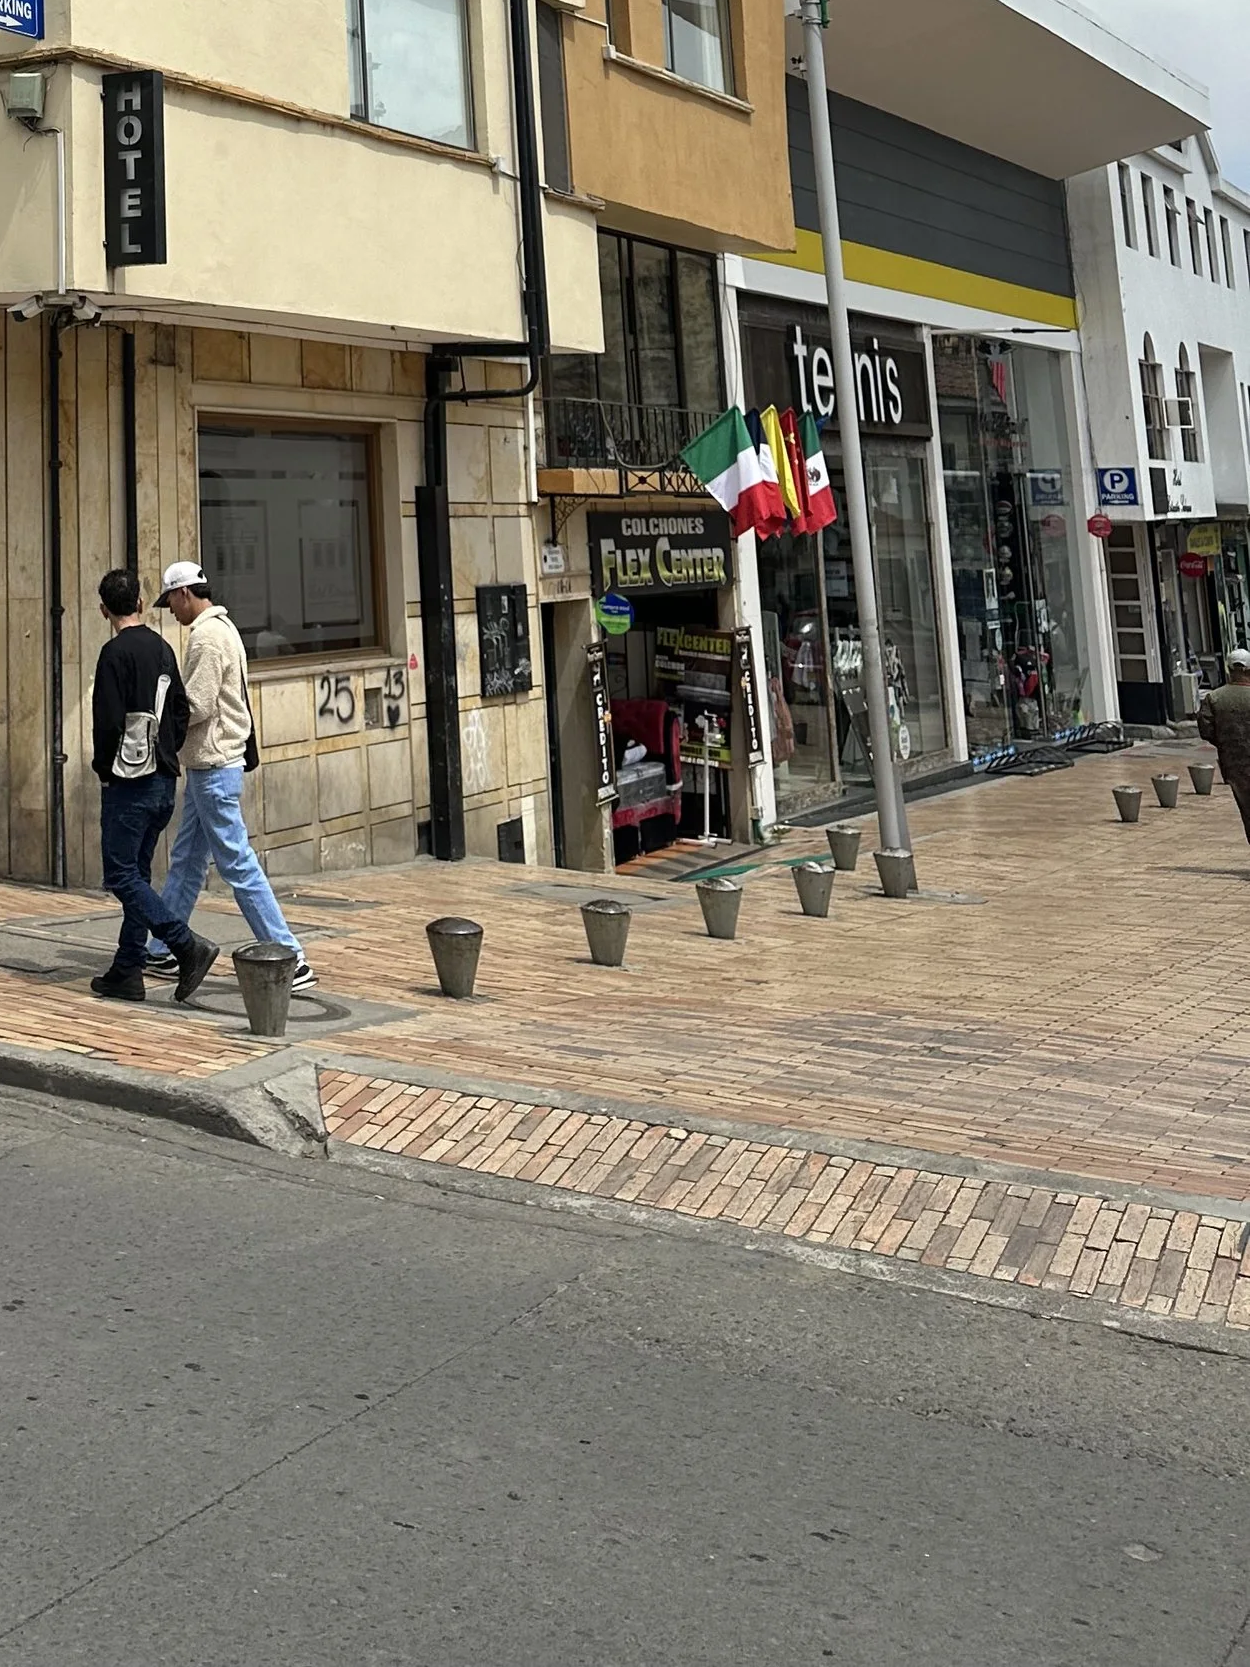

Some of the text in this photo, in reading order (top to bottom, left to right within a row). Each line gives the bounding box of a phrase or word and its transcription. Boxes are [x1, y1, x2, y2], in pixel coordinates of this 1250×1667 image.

[116, 81, 143, 254] HOTEL
[793, 325, 902, 425] tenis
[1101, 493, 1135, 501] PARKING
[1109, 472, 1124, 490] P
[621, 517, 705, 536] COLCHONES
[600, 536, 728, 591] FLEX CENTER
[596, 693, 610, 784] CREDITO
